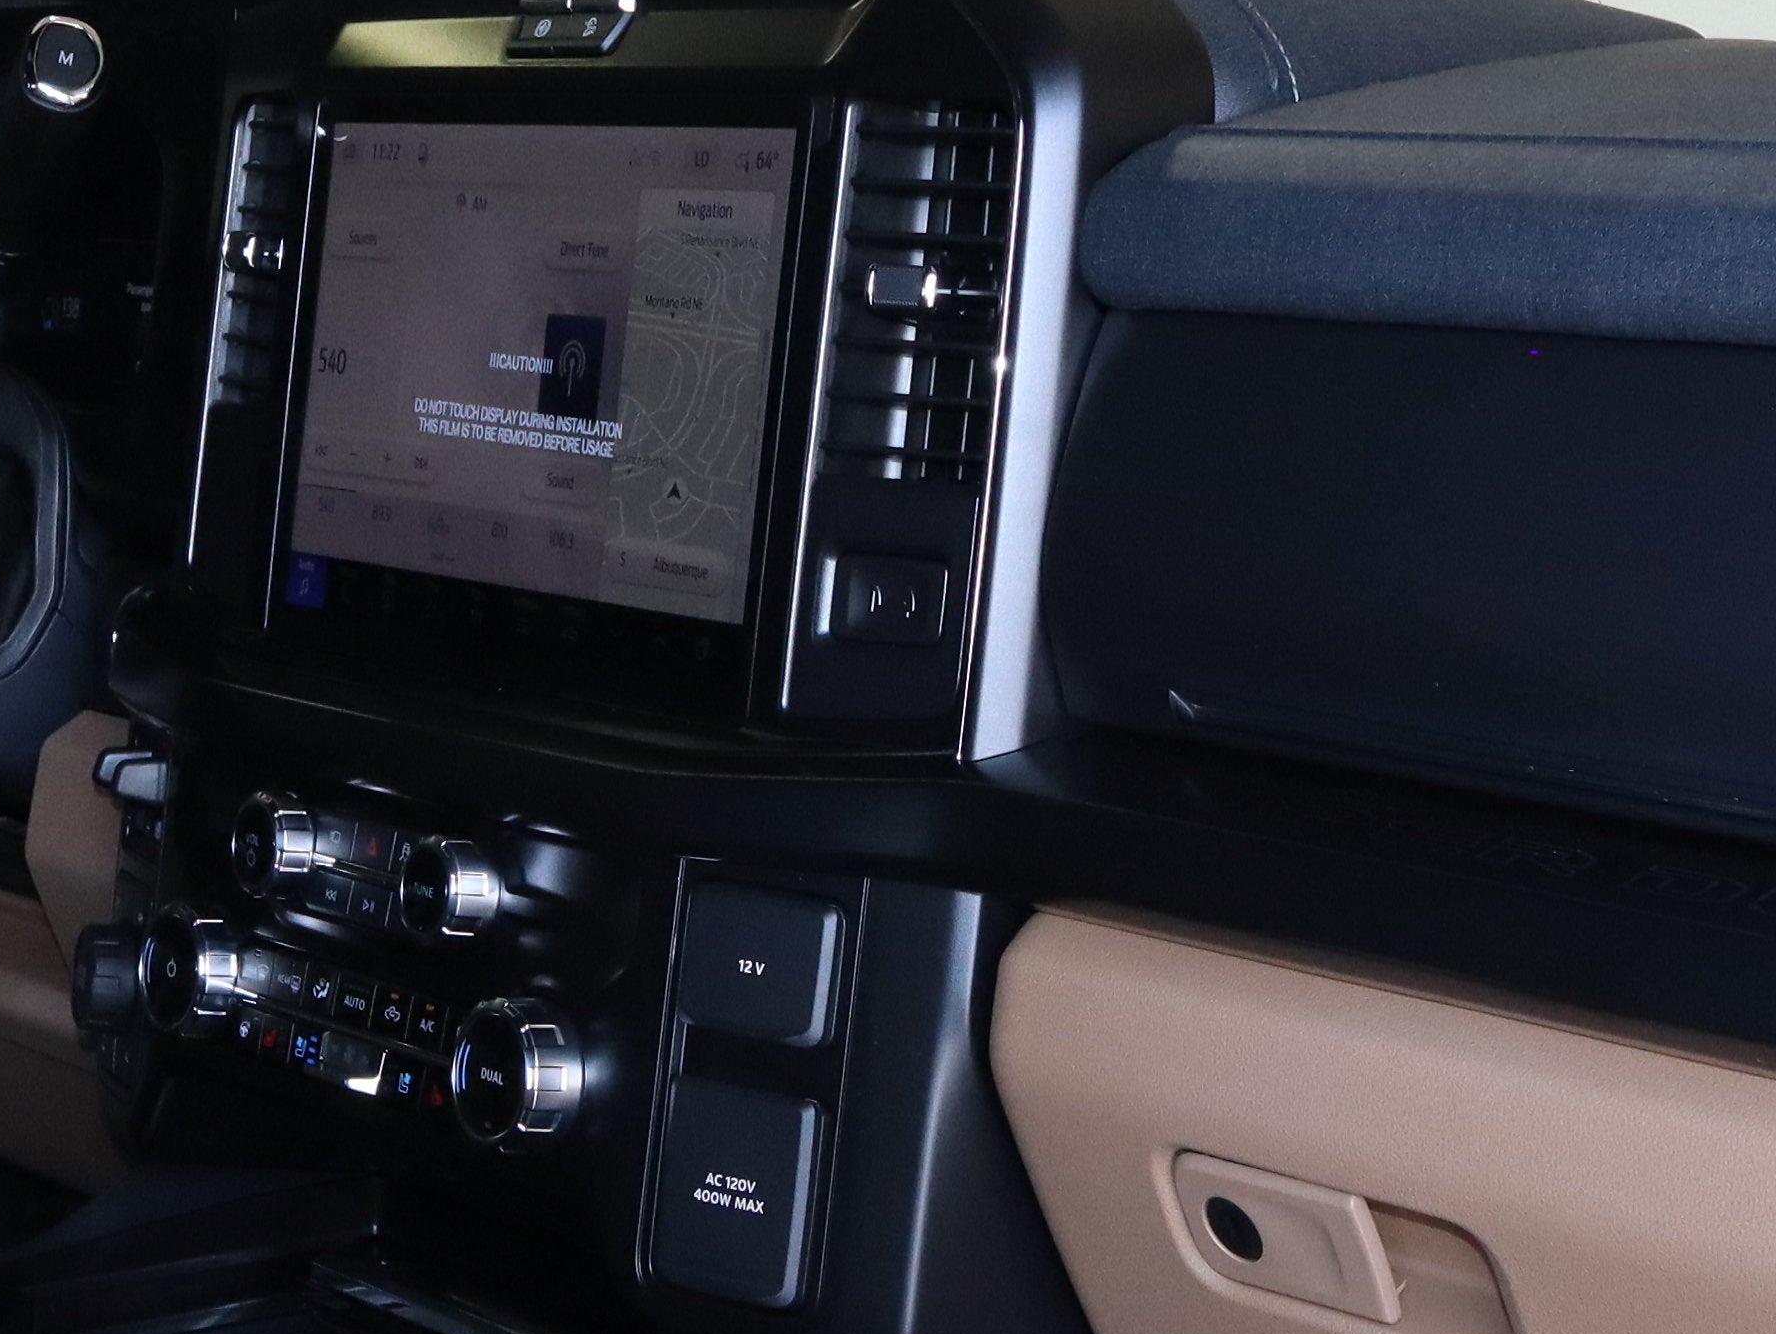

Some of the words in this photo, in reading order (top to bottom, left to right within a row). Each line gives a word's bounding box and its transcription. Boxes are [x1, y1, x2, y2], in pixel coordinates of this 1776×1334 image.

[58, 49, 74, 67] M
[677, 200, 733, 221] Navigation
[317, 347, 346, 375] 540
[414, 397, 428, 413] DO
[428, 399, 448, 416] NOT
[448, 401, 480, 421] TOUCH
[480, 406, 519, 427] DISPLAY
[518, 411, 555, 431] DURING
[556, 415, 623, 440] INSTALLATION
[418, 417, 438, 434] THIS
[438, 420, 460, 437] FILM
[460, 422, 470, 439] IS
[471, 423, 483, 440] TO
[484, 425, 497, 442] BE
[497, 427, 543, 449] REMOVED
[543, 434, 581, 454] BEFORE
[581, 439, 615, 459] USAGE
[652, 557, 709, 580] Albuquerque
[737, 958, 753, 975] 12
[754, 961, 766, 976] V
[343, 994, 367, 1012] AUTO
[419, 1018, 437, 1035] A/C
[480, 1066, 504, 1086] DUAL
[704, 1171, 725, 1188] AC
[725, 1175, 757, 1194] 120V
[692, 1188, 732, 1209] 400W
[734, 1196, 765, 1215] MAX
